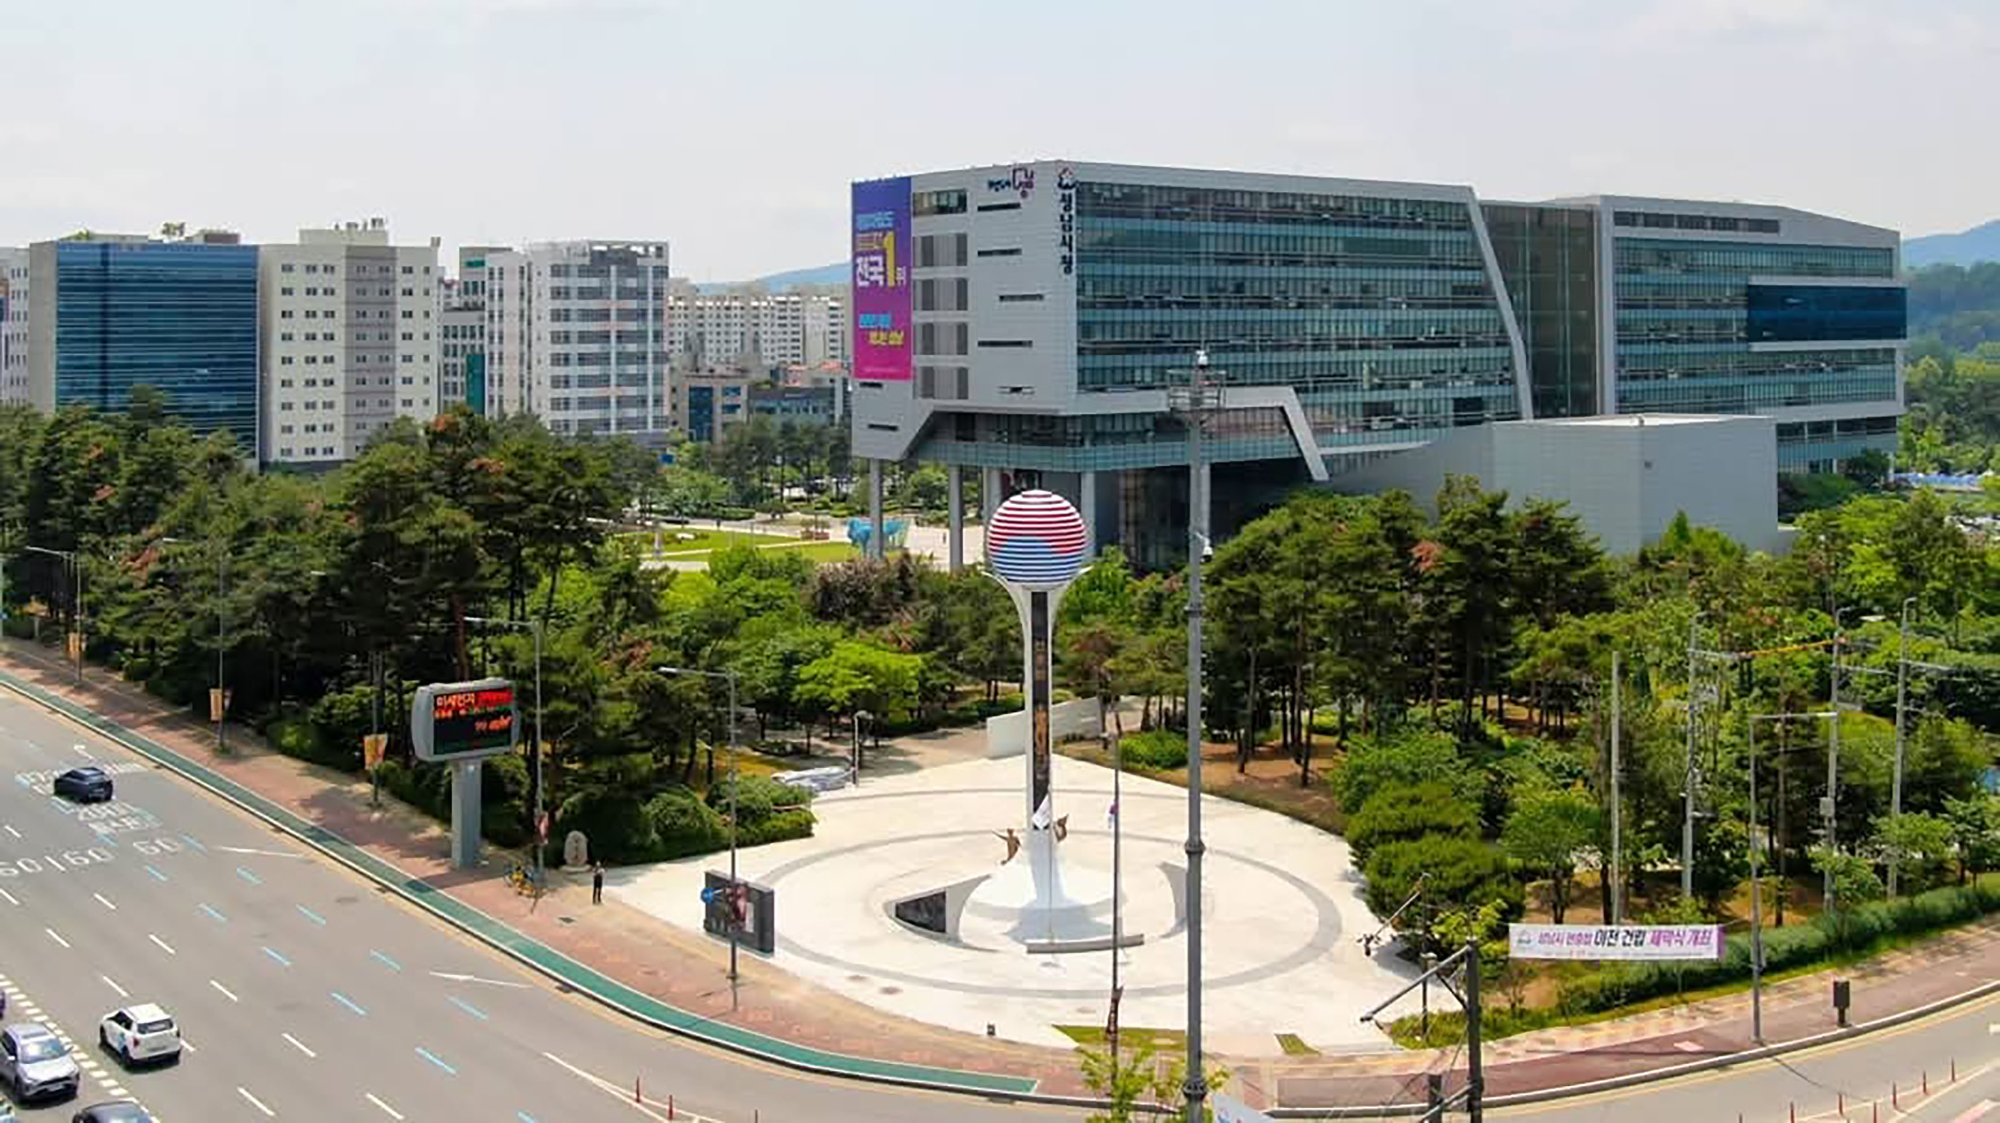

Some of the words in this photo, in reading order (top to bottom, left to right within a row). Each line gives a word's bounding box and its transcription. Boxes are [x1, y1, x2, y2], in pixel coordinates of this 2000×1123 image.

[1059, 192, 1073, 275] 성남시청
[63, 846, 116, 866] 60
[1593, 929, 1620, 947] 이전
[1621, 929, 1647, 947] 건립
